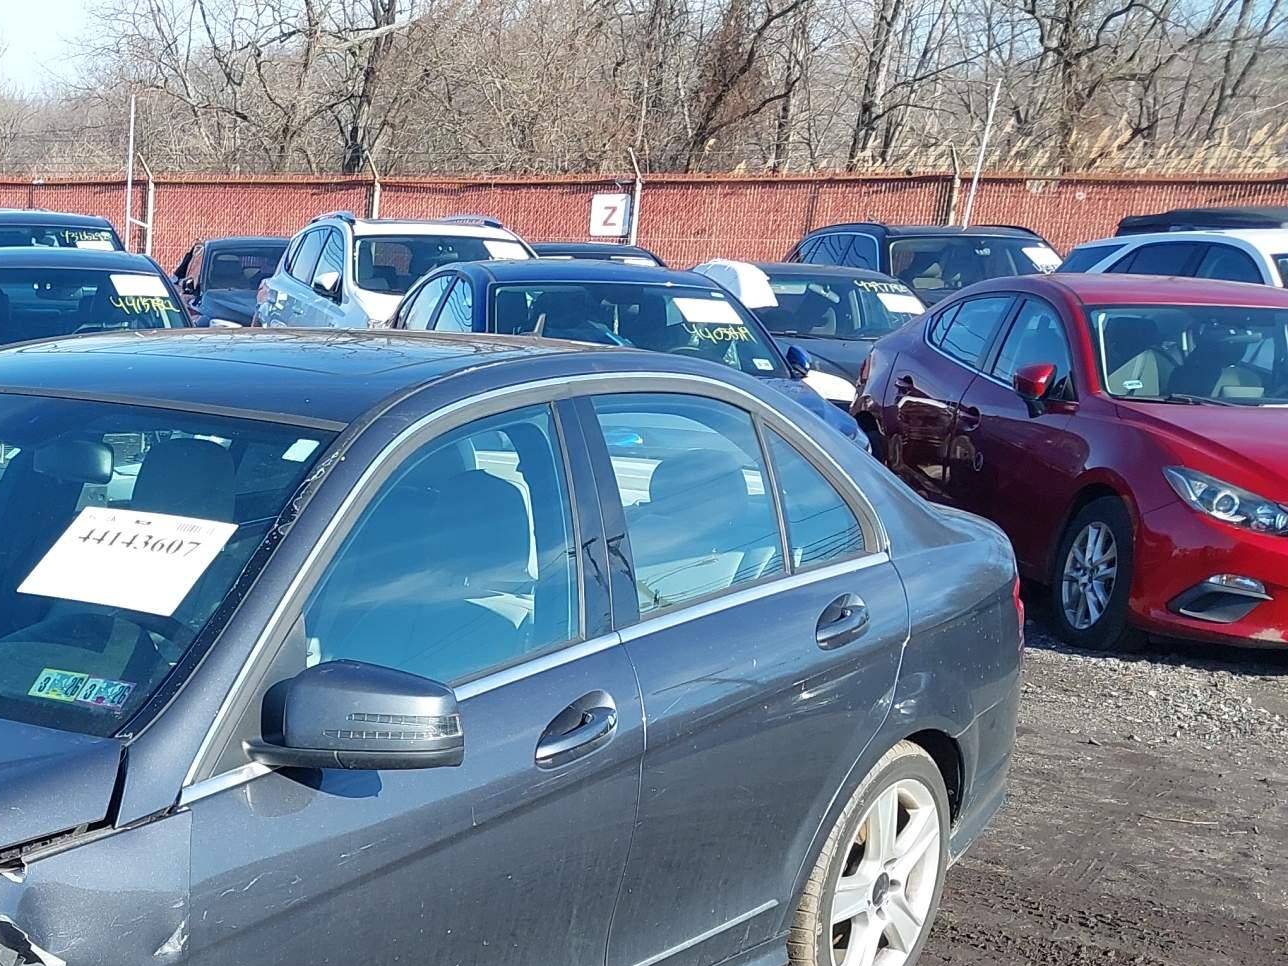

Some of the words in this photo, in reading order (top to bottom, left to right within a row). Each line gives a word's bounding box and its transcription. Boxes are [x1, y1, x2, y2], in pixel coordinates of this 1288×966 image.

[601, 206, 618, 226] Z
[78, 528, 202, 557] 44143607
[37, 676, 51, 692] 3
[64, 677, 83, 697] 26
[83, 683, 97, 700] 3
